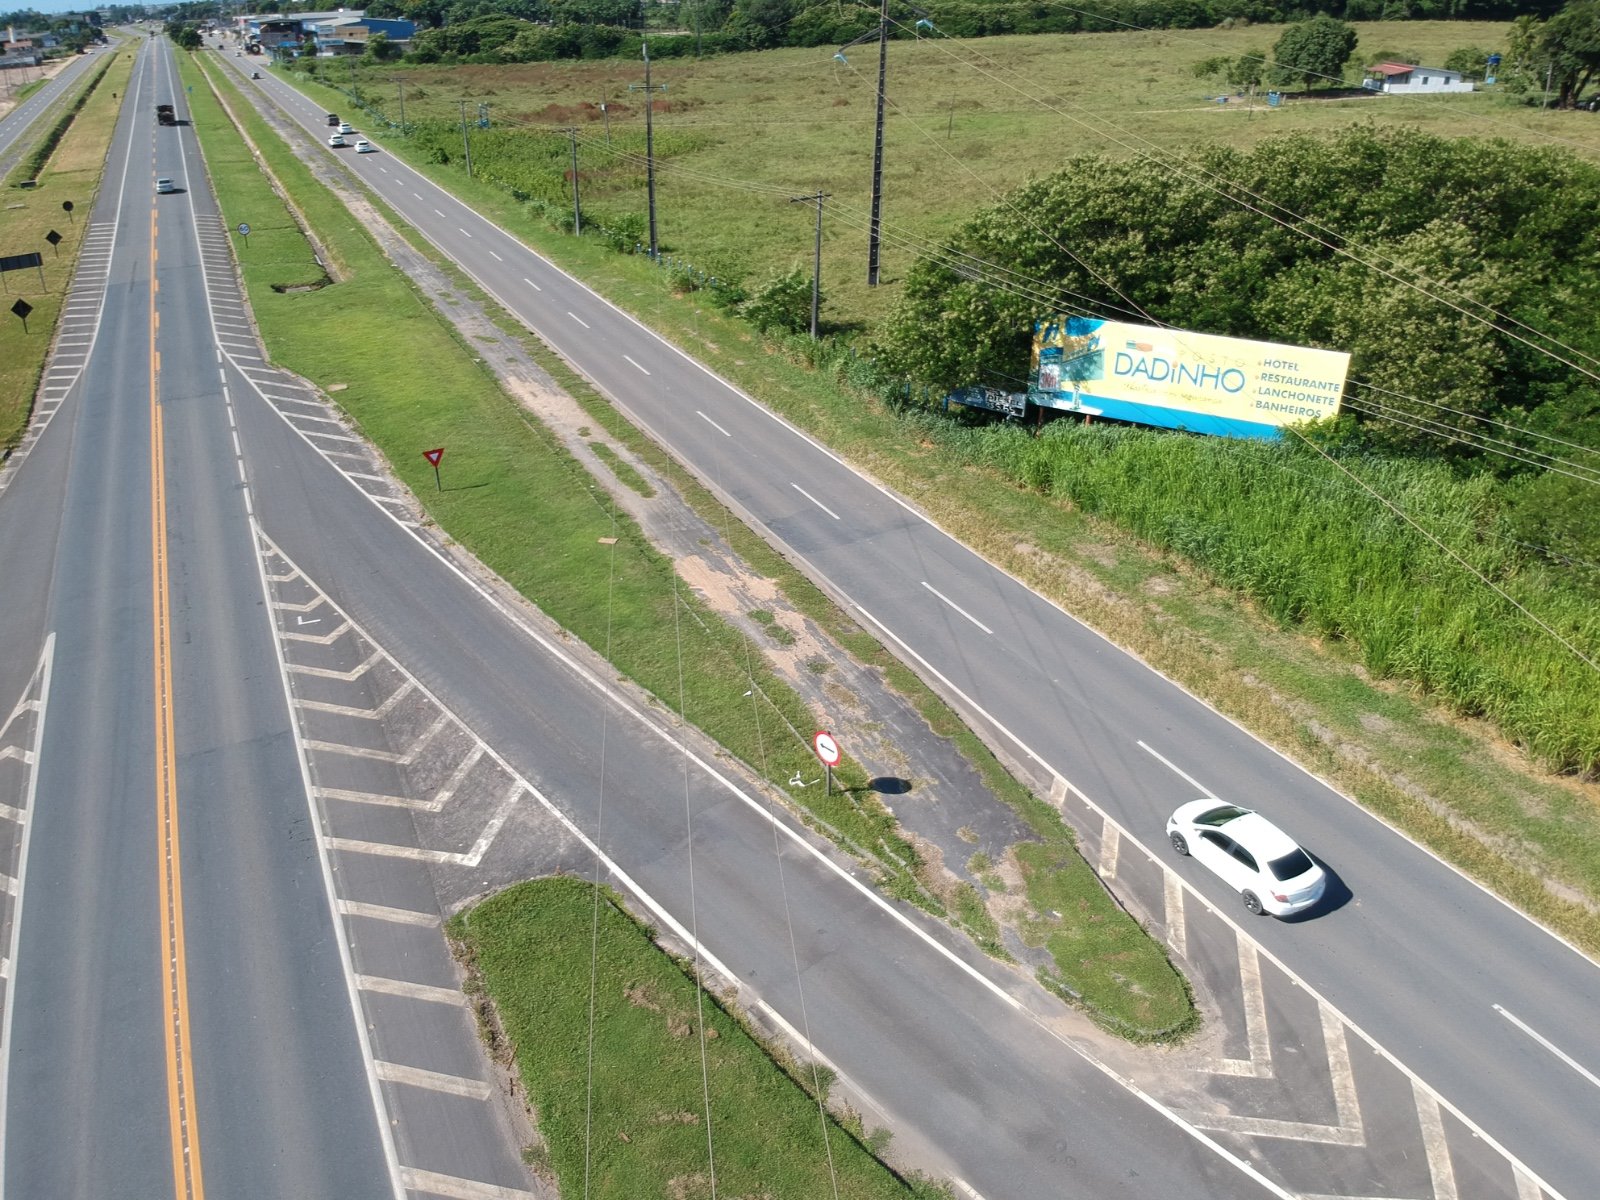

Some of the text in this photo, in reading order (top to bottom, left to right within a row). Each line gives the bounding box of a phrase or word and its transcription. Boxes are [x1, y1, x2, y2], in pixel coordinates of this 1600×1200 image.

[1263, 358, 1300, 372] HOTEL
[1260, 372, 1340, 393] RESTAURANTE
[1258, 386, 1335, 406] LANCHONETE
[1255, 400, 1322, 419] BANHEIROS
